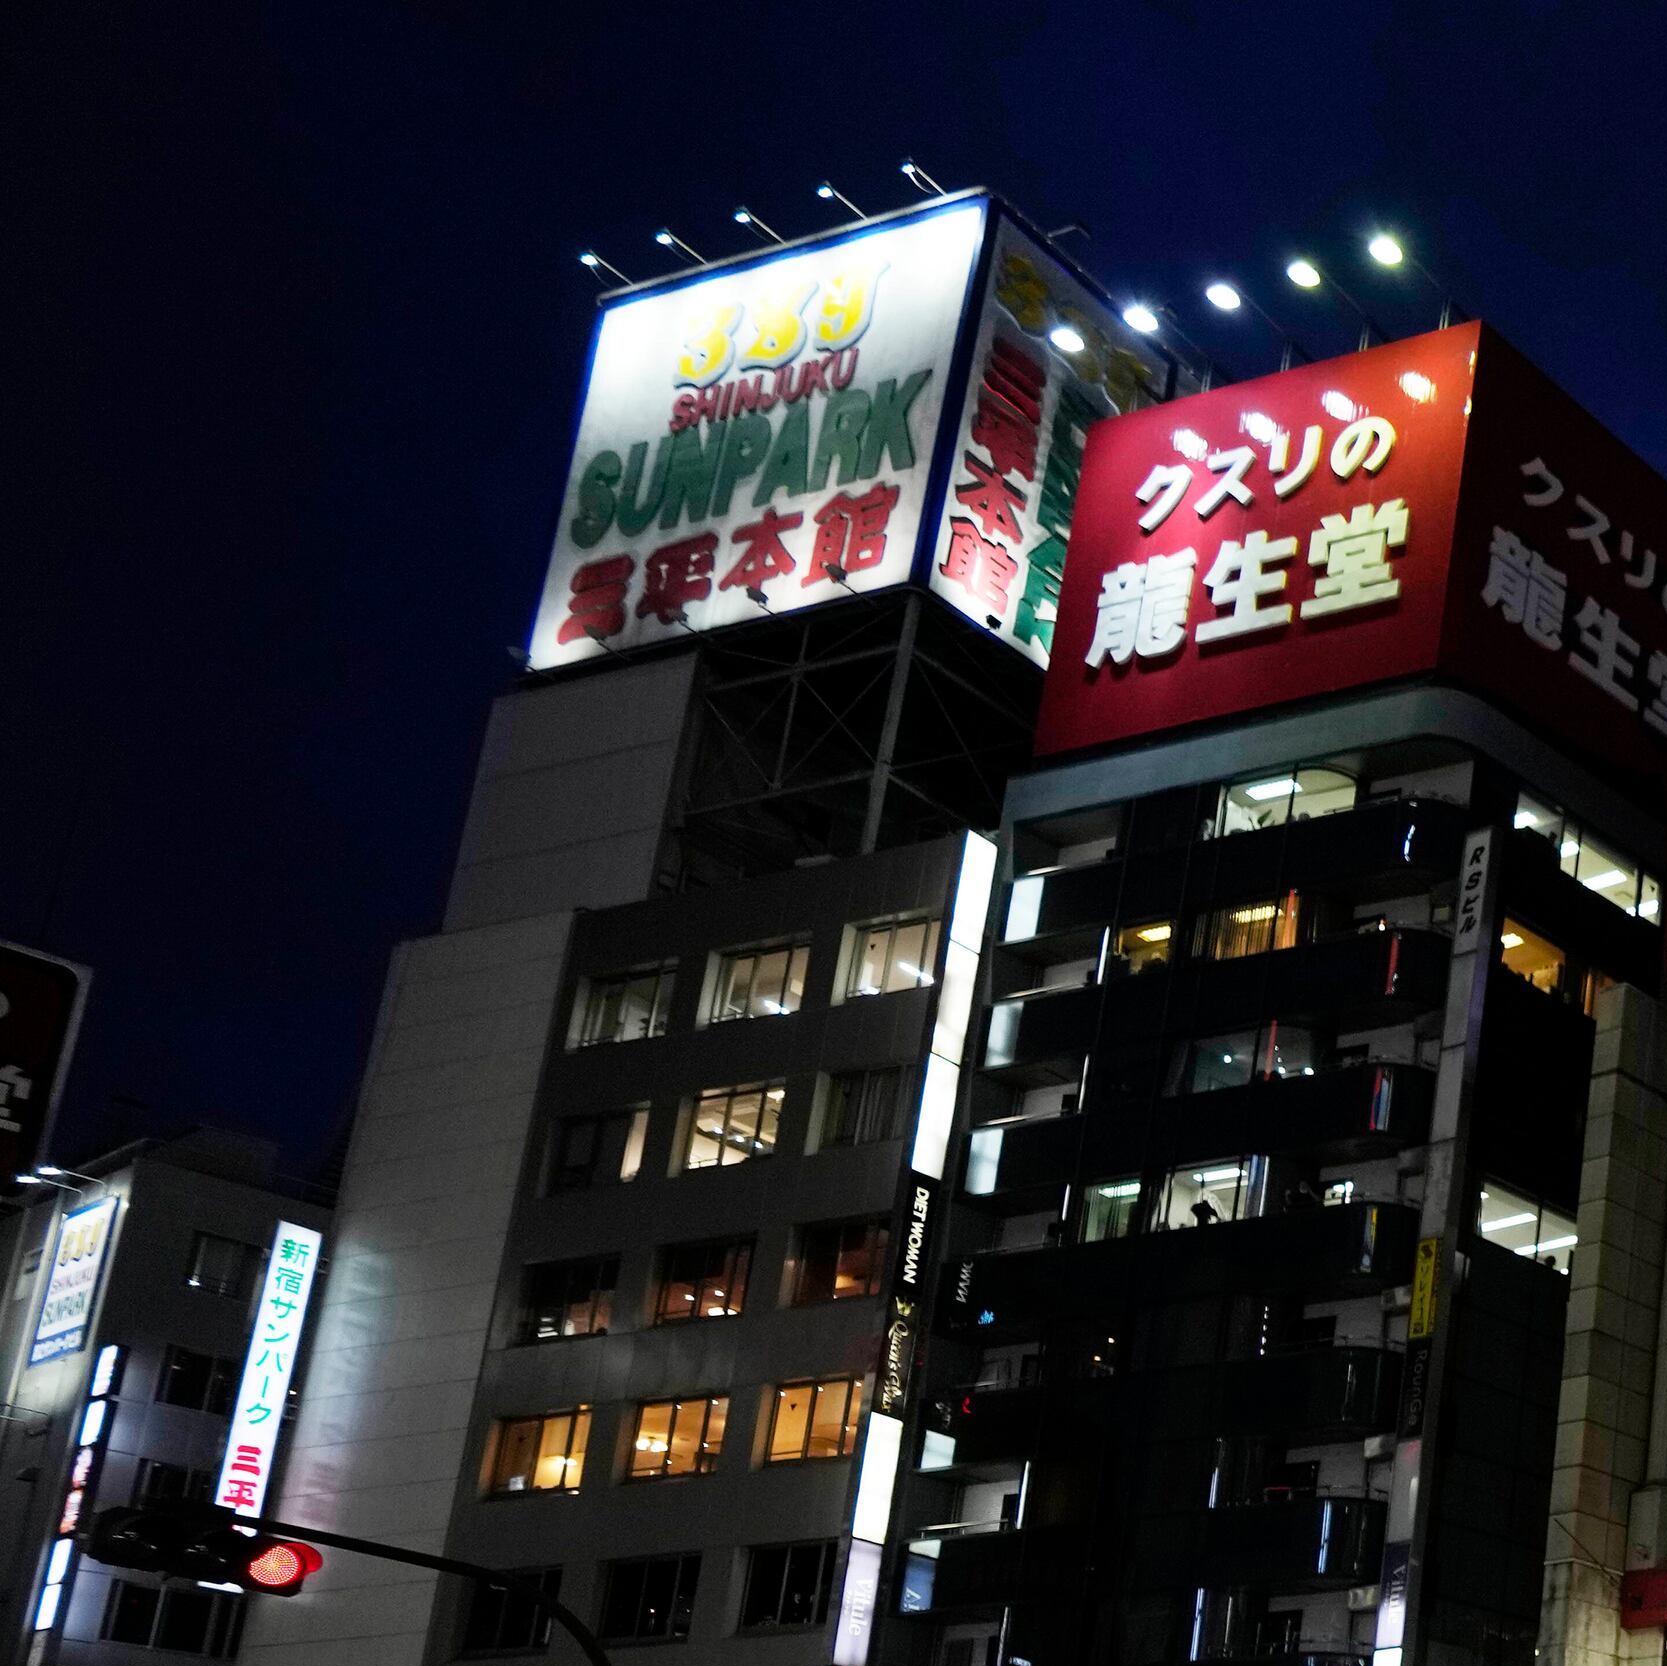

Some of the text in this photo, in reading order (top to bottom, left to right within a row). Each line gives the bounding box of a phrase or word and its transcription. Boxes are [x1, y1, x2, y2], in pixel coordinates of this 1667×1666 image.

[570, 369, 933, 549] SUNPARK
[670, 348, 862, 431] SHINJUKU
[1135, 416, 1397, 532] クスリの
[557, 483, 901, 646] 三平本館
[1085, 497, 1409, 670] 龍生堂
[903, 1186, 930, 1285] DIET WOMAN
[245, 1239, 309, 1426] 新宿サンパーク
[223, 1445, 261, 1508] 三平
